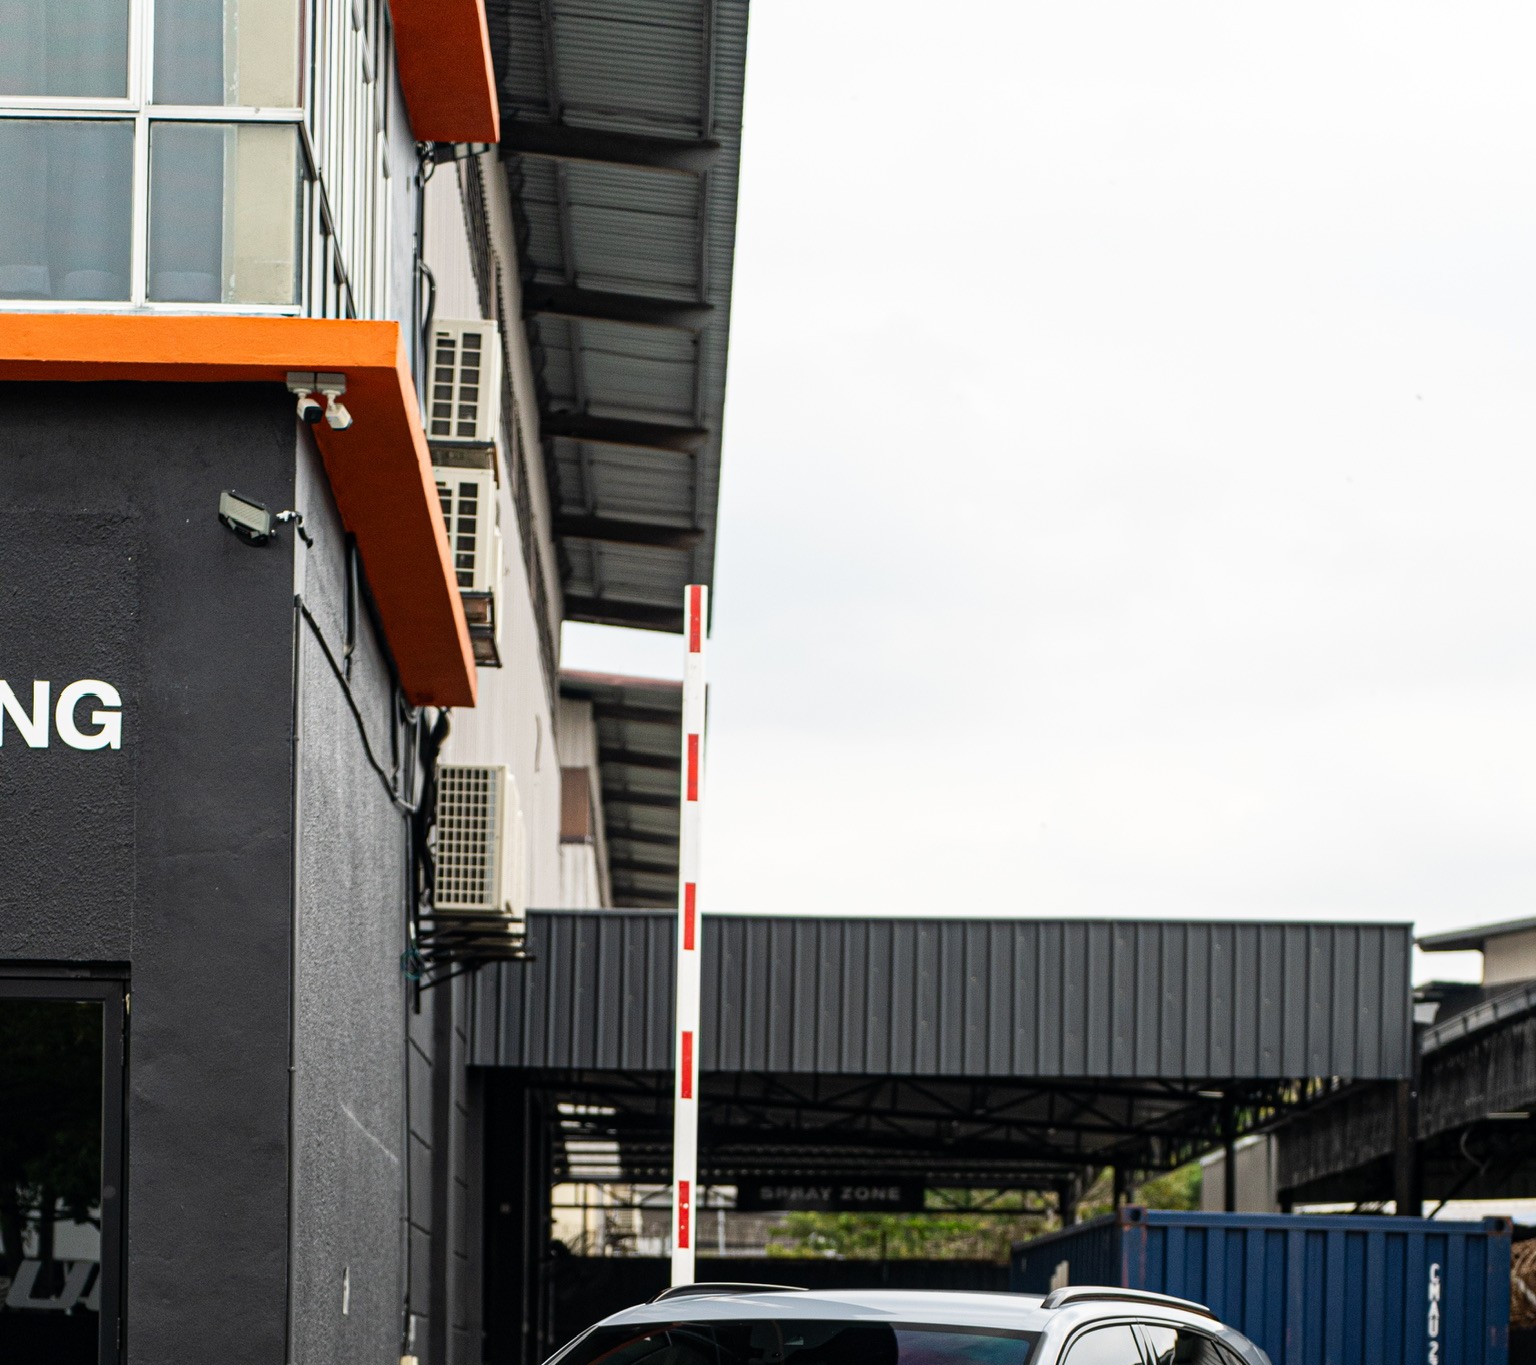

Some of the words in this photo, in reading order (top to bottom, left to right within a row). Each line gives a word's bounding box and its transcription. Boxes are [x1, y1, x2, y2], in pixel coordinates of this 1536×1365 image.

[0, 679, 122, 750] NG
[759, 1185, 832, 1200] SPRAY
[840, 1185, 903, 1200] ZONE
[1427, 1263, 1440, 1338] CMAU
